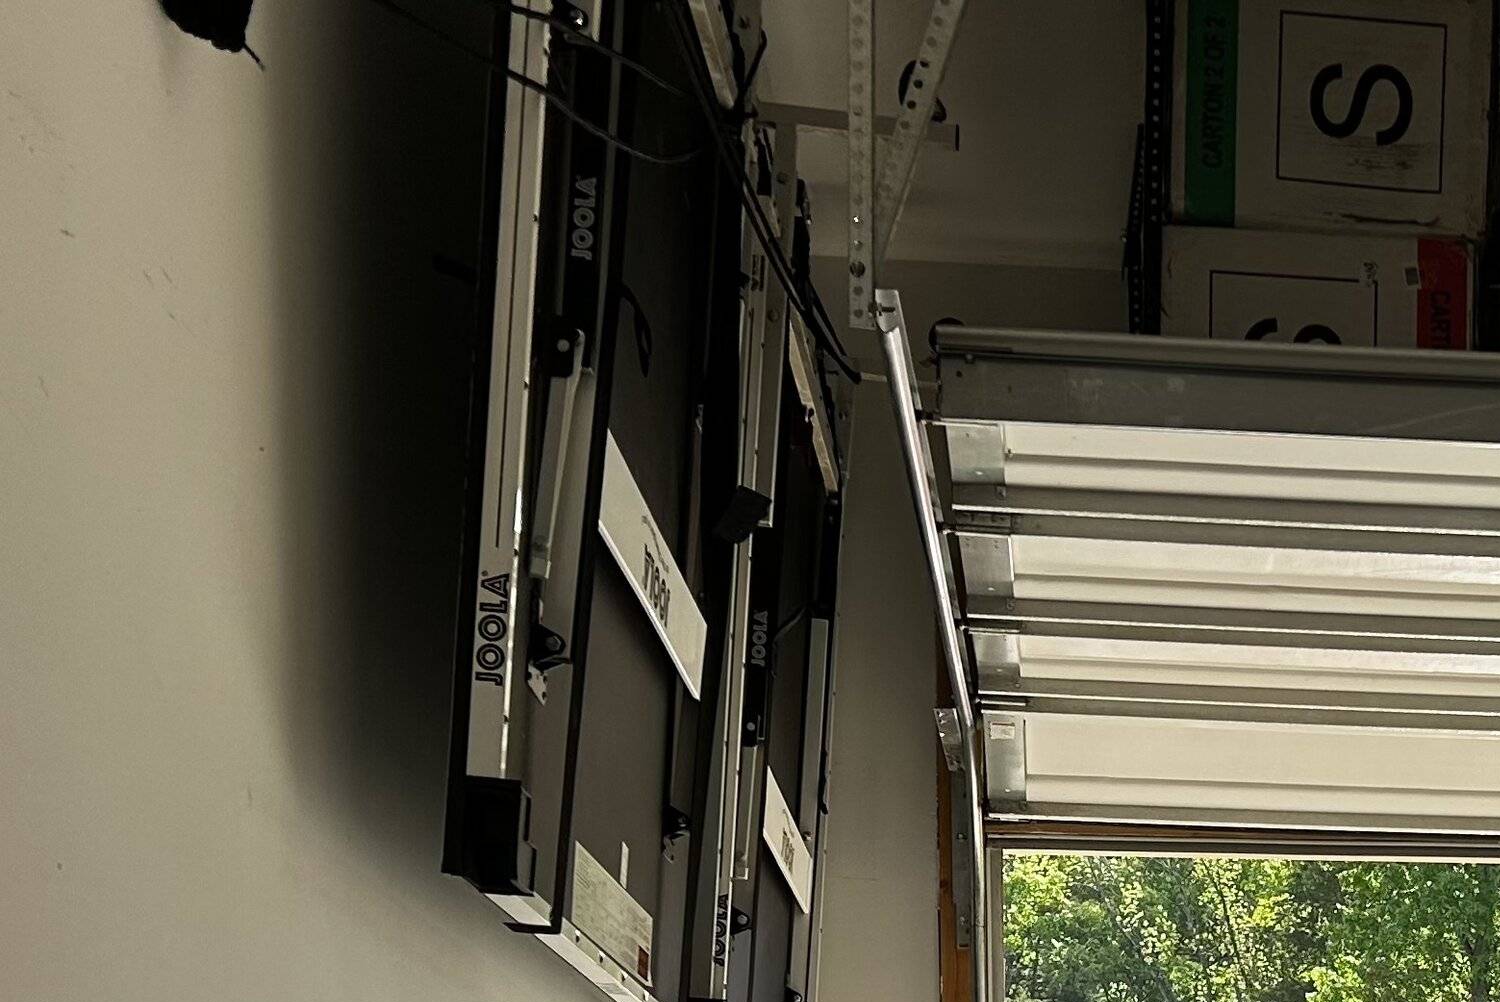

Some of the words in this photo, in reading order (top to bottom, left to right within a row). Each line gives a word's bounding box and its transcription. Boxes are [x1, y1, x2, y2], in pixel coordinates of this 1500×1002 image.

[1202, 83, 1224, 169] CARTON
[1310, 63, 1413, 146] S
[571, 176, 597, 261] JOOLA
[475, 572, 511, 686] JOOLA
[751, 610, 769, 668] JOOLA
[713, 893, 728, 967] JOOLA
